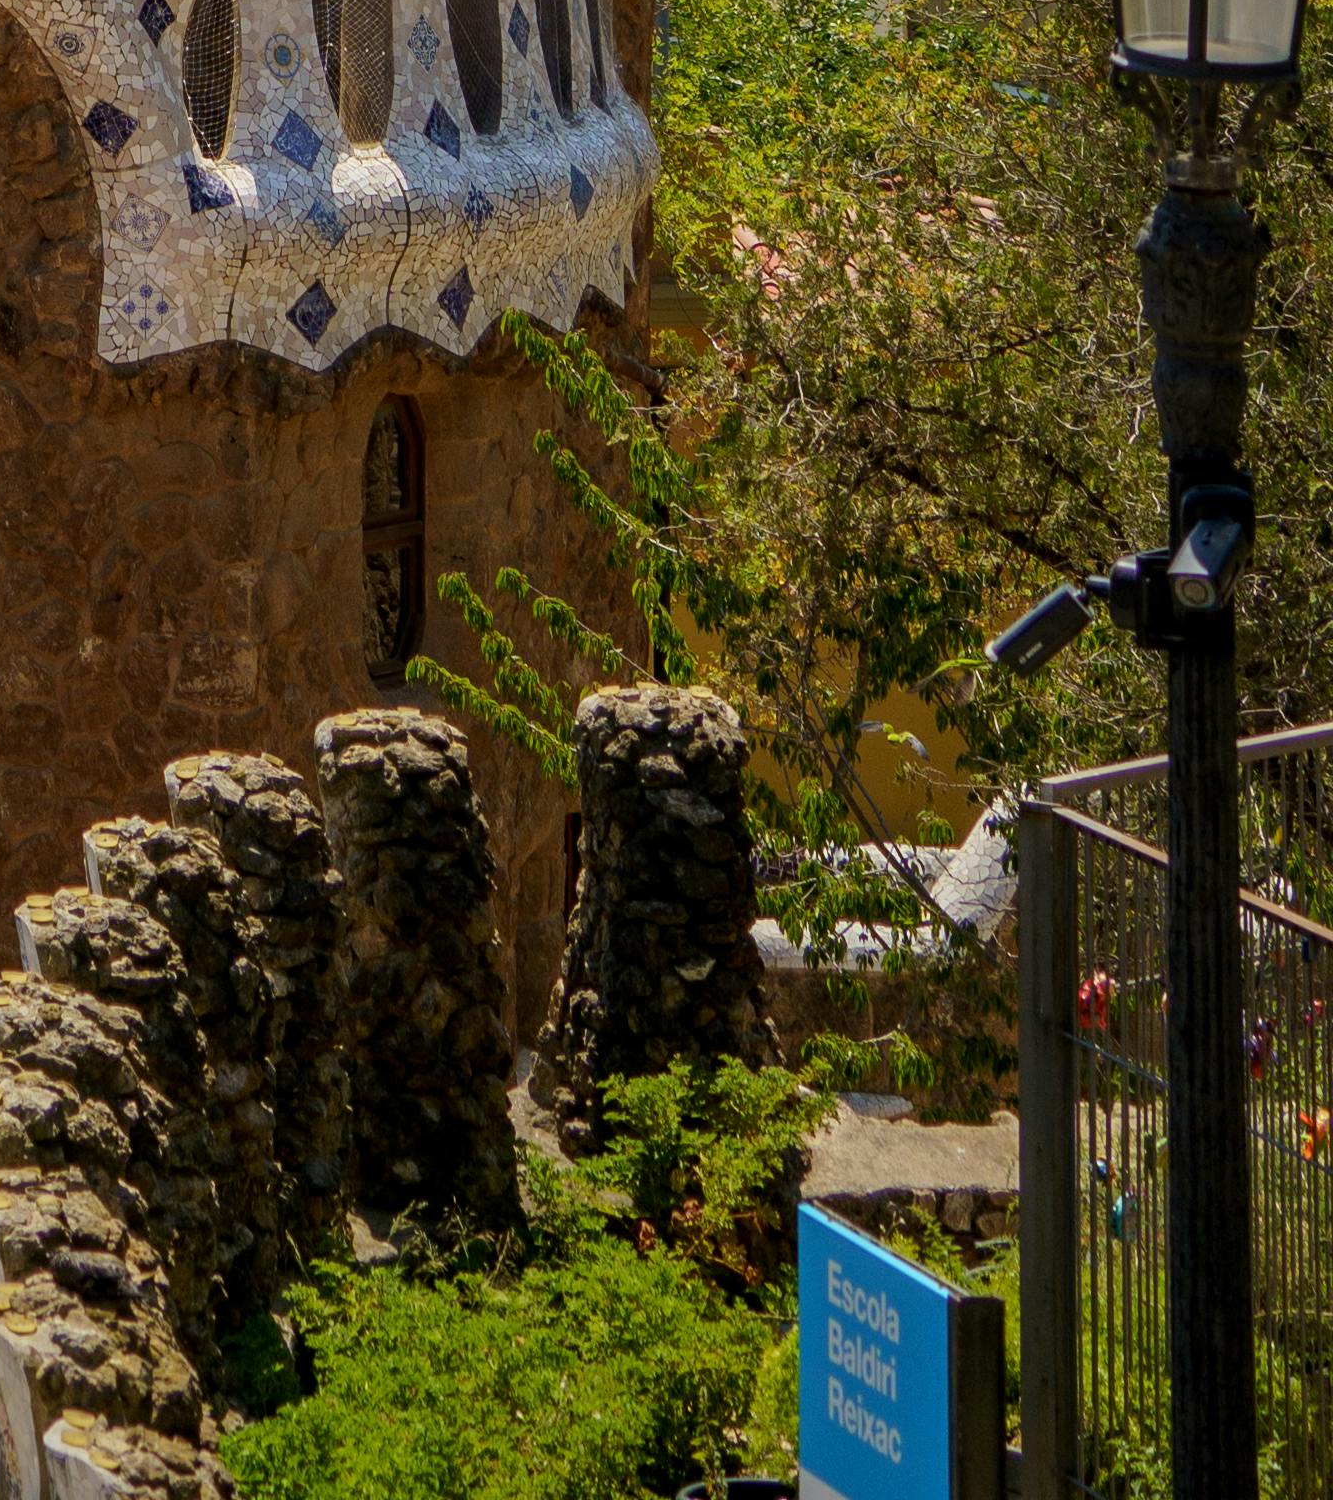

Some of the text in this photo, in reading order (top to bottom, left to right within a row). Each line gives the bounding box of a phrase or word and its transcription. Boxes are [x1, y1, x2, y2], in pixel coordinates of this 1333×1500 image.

[827, 1259, 900, 1345] Escola
[827, 1317, 897, 1402] Baldiri
[827, 1375, 902, 1464] Reixac
